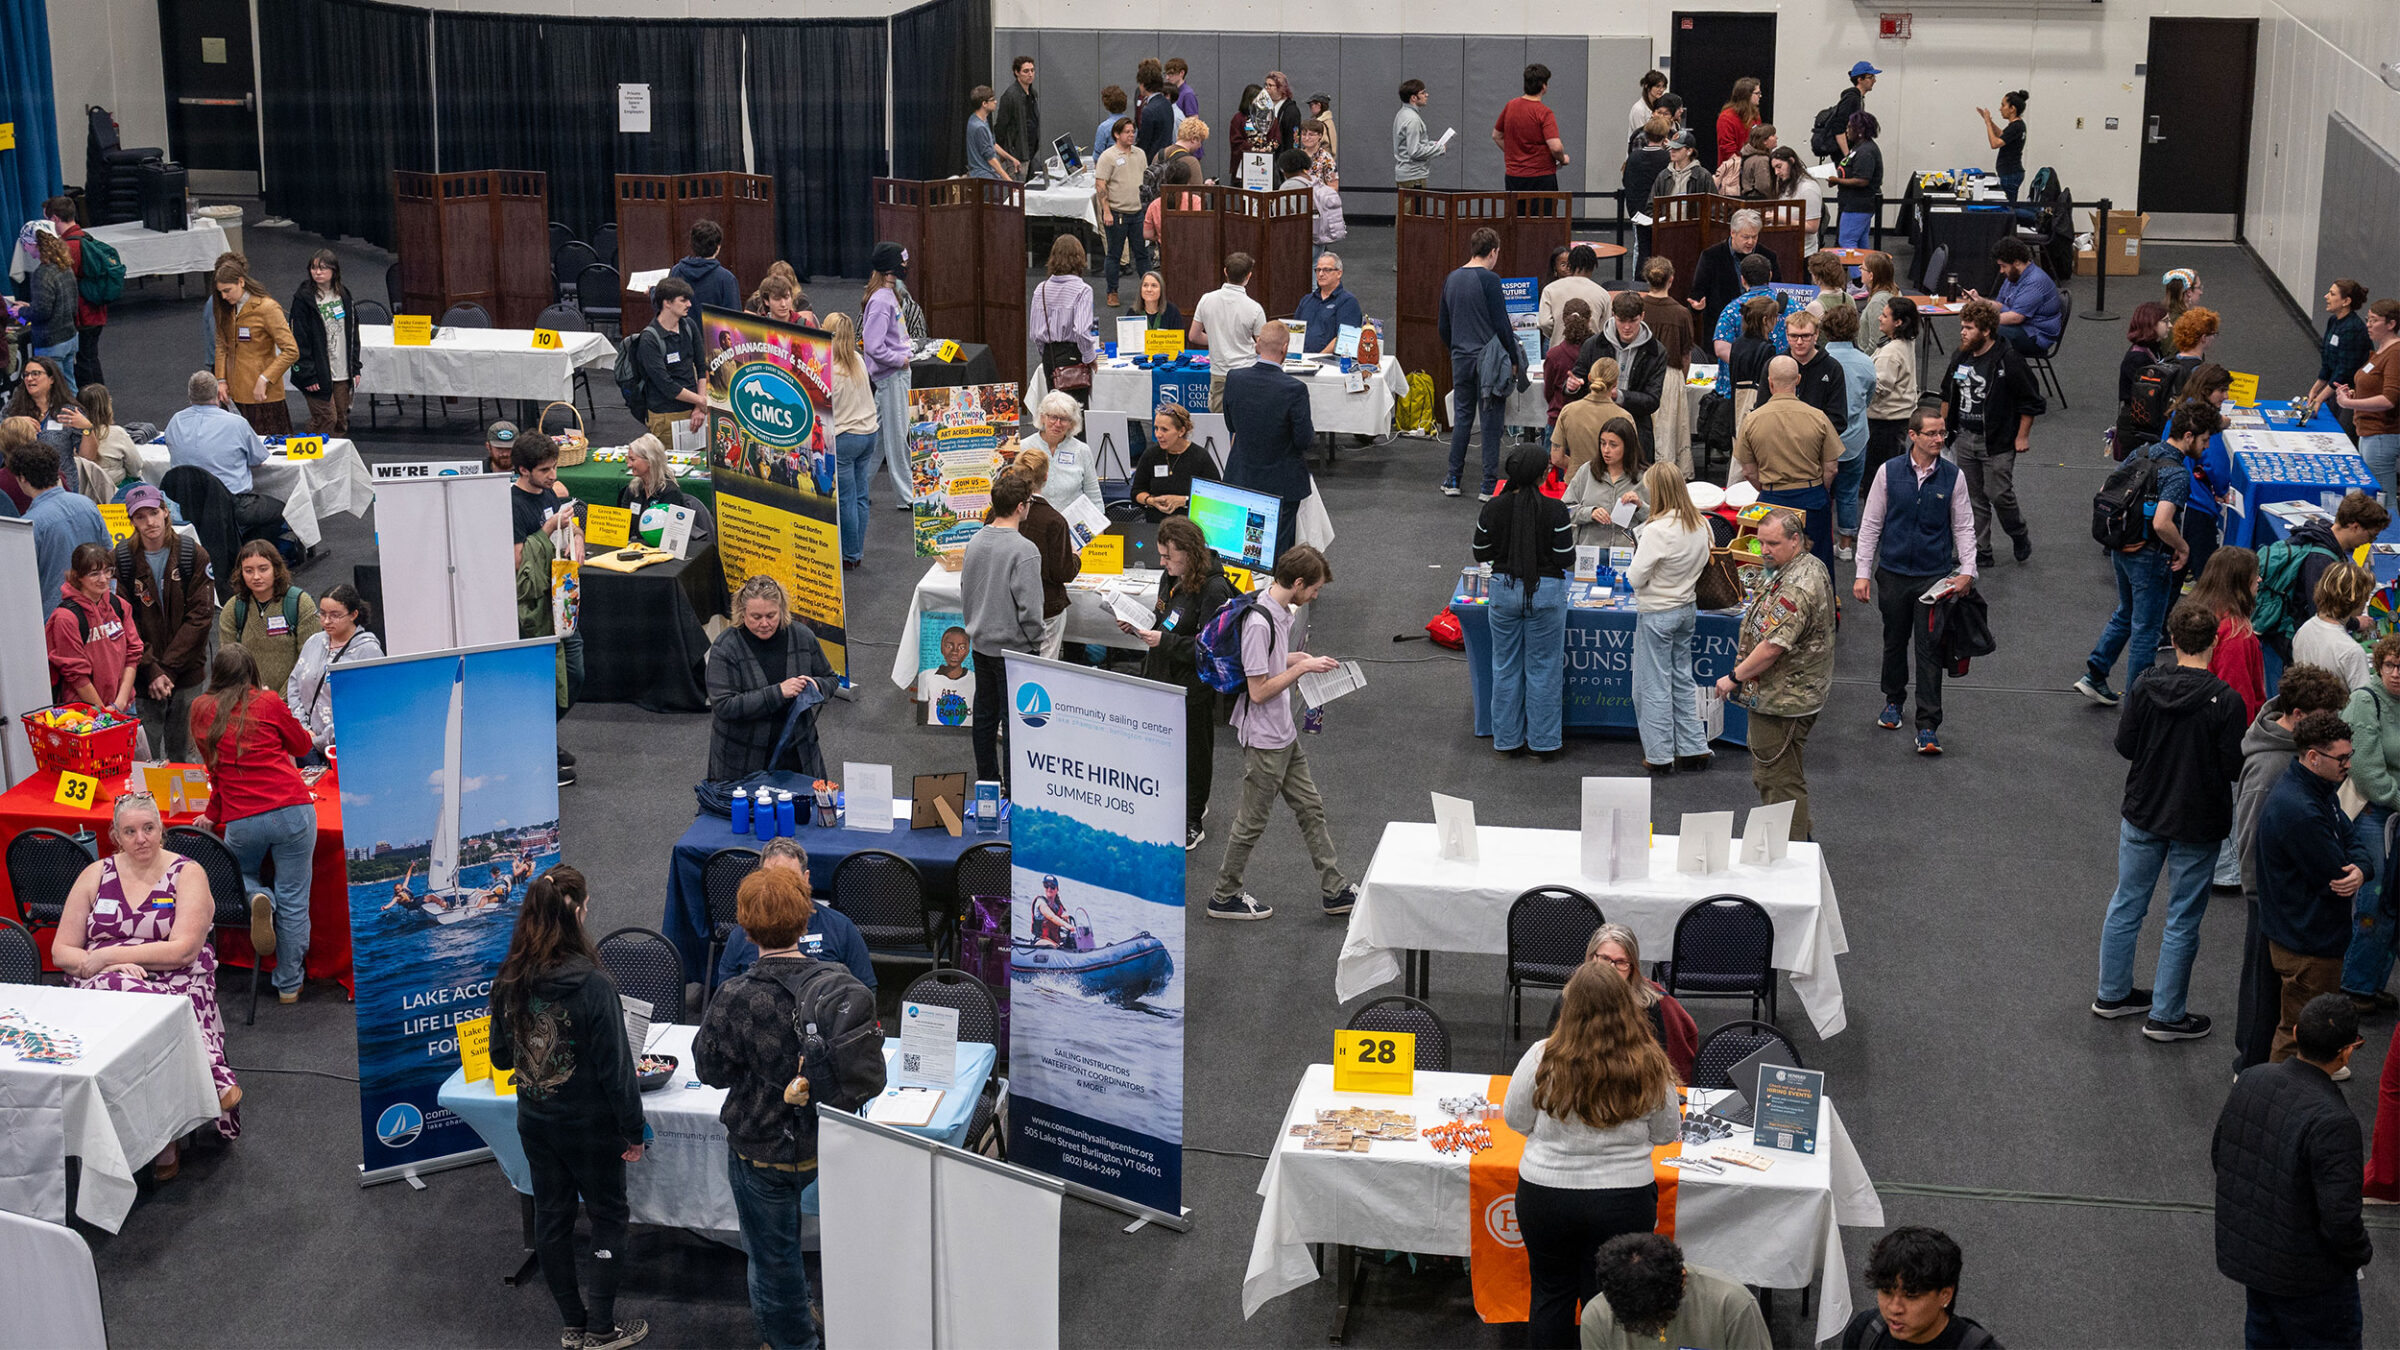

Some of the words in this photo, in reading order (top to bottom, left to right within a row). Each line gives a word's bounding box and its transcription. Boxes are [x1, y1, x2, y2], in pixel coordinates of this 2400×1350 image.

[538, 333, 551, 345] 10
[710, 347, 735, 371] CROWD
[734, 342, 789, 360] MANAGEMENT
[789, 355, 796, 366] &
[797, 358, 833, 399] SECURITY
[1188, 383, 1209, 392] CHA
[1188, 391, 1208, 400] COL
[1188, 400, 1208, 408] ONL
[751, 402, 794, 429] GMCS
[944, 410, 985, 424] PATCHWORK
[952, 418, 978, 427] PLANET
[941, 430, 951, 438] ART
[293, 441, 317, 455] 40
[955, 479, 970, 488] JOIN
[738, 505, 752, 515] Events
[112, 520, 132, 528] (VELC
[722, 511, 755, 526] Commencement
[756, 521, 780, 533] Ceremonies
[793, 521, 806, 530] Quad
[806, 525, 822, 535] Bonfire
[756, 531, 771, 540] Events
[752, 540, 781, 554] Engagements
[1084, 542, 1114, 550] atchwork
[794, 552, 810, 564] Library
[823, 592, 841, 604] Security
[941, 688, 957, 697] ART
[936, 697, 967, 707] ACROSS
[1054, 702, 1107, 722] community
[1109, 713, 1139, 730] sailing
[1142, 721, 1174, 735] center
[1027, 750, 1084, 780] WE'RE
[1088, 764, 1160, 797] HIRING!
[64, 778, 88, 801] 33
[1046, 783, 1102, 807] SUMMER
[1104, 796, 1135, 815] JOBS
[402, 988, 449, 1011] LAKE
[453, 980, 493, 1001] ACC
[404, 1015, 440, 1036] LIFE
[463, 1026, 482, 1038] Lake
[1358, 1038, 1396, 1064] 28
[1054, 1048, 1082, 1063] SAILING
[1082, 1057, 1130, 1077] INSTRUCTORS
[1041, 1056, 1087, 1076] WATERFRONT
[1088, 1070, 1145, 1093] COORDINATORS
[1076, 1079, 1083, 1087] &
[1083, 1081, 1107, 1095] MORE!
[1766, 1087, 1787, 1096] HIRING
[427, 1122, 443, 1131] lake
[657, 1129, 707, 1141] community
[1031, 1116, 1154, 1162] www.communitysailingcenter.org
[1024, 1126, 1039, 1138] 505
[1039, 1131, 1057, 1144] Lake
[1057, 1136, 1080, 1151] Street
[1081, 1145, 1122, 1165] Burlington,
[1124, 1158, 1136, 1168] VT
[1135, 1161, 1162, 1178] 05401
[1062, 1154, 1083, 1168] (802)
[1083, 1161, 1121, 1179] 864-2499
